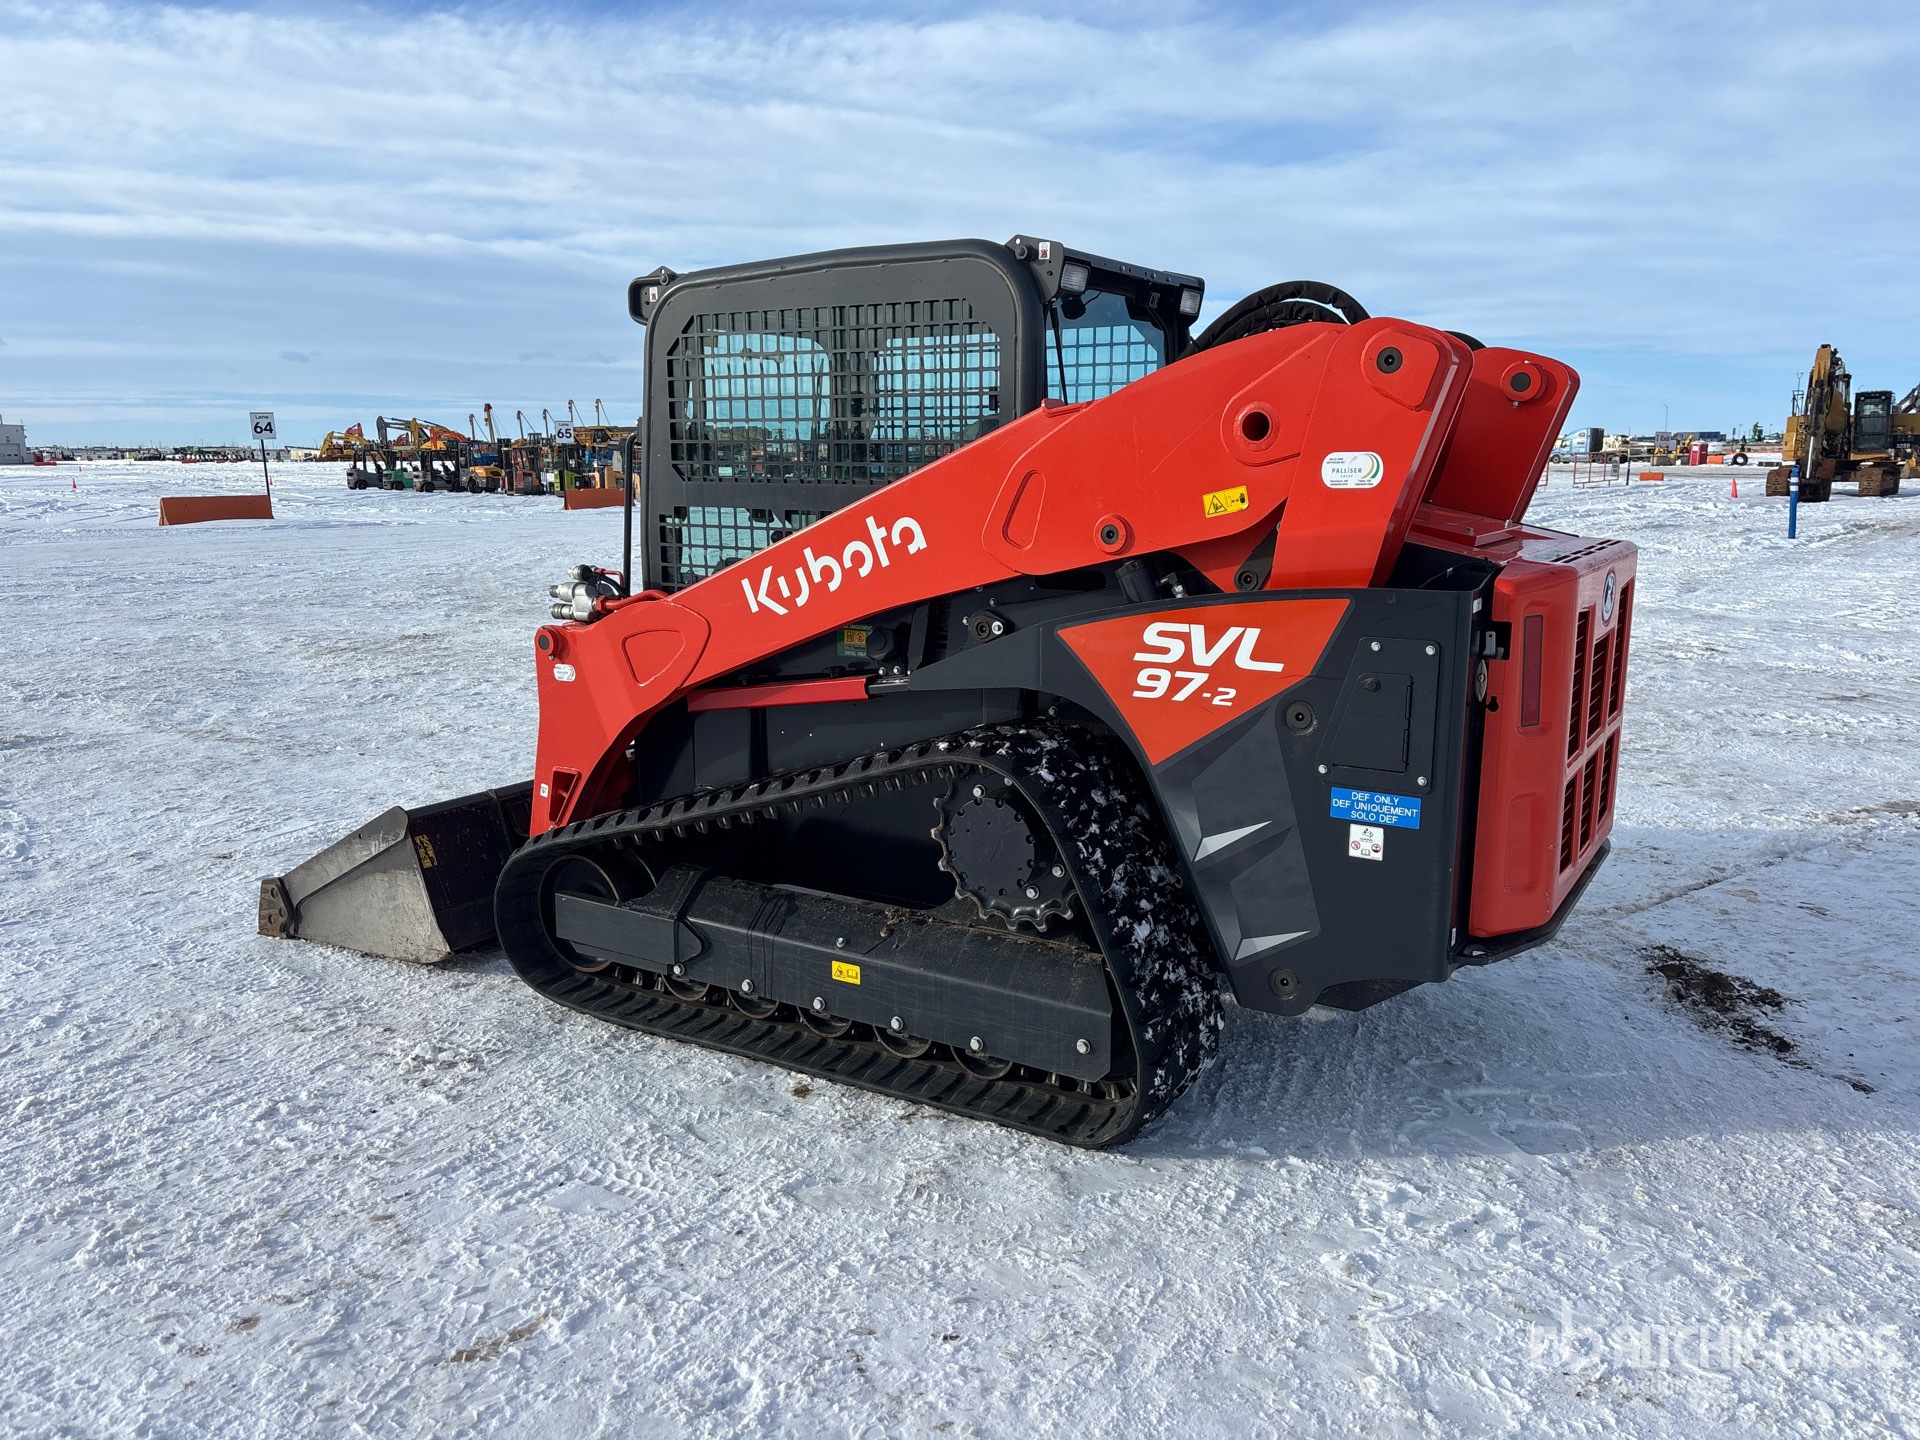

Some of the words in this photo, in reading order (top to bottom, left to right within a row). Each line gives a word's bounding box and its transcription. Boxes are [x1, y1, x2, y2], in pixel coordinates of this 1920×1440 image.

[253, 421, 274, 434] 64
[557, 428, 572, 439] 65
[741, 515, 928, 616] Kubota
[1133, 621, 1285, 673] SVL
[1132, 667, 1237, 707] 97-2
[1351, 791, 1371, 802] DEF
[1374, 795, 1400, 806] ONLY
[1332, 798, 1352, 808] DEF
[1354, 801, 1418, 818] UNIQUEMENT
[1350, 810, 1376, 821] SOLO
[1379, 814, 1399, 824] DEF
